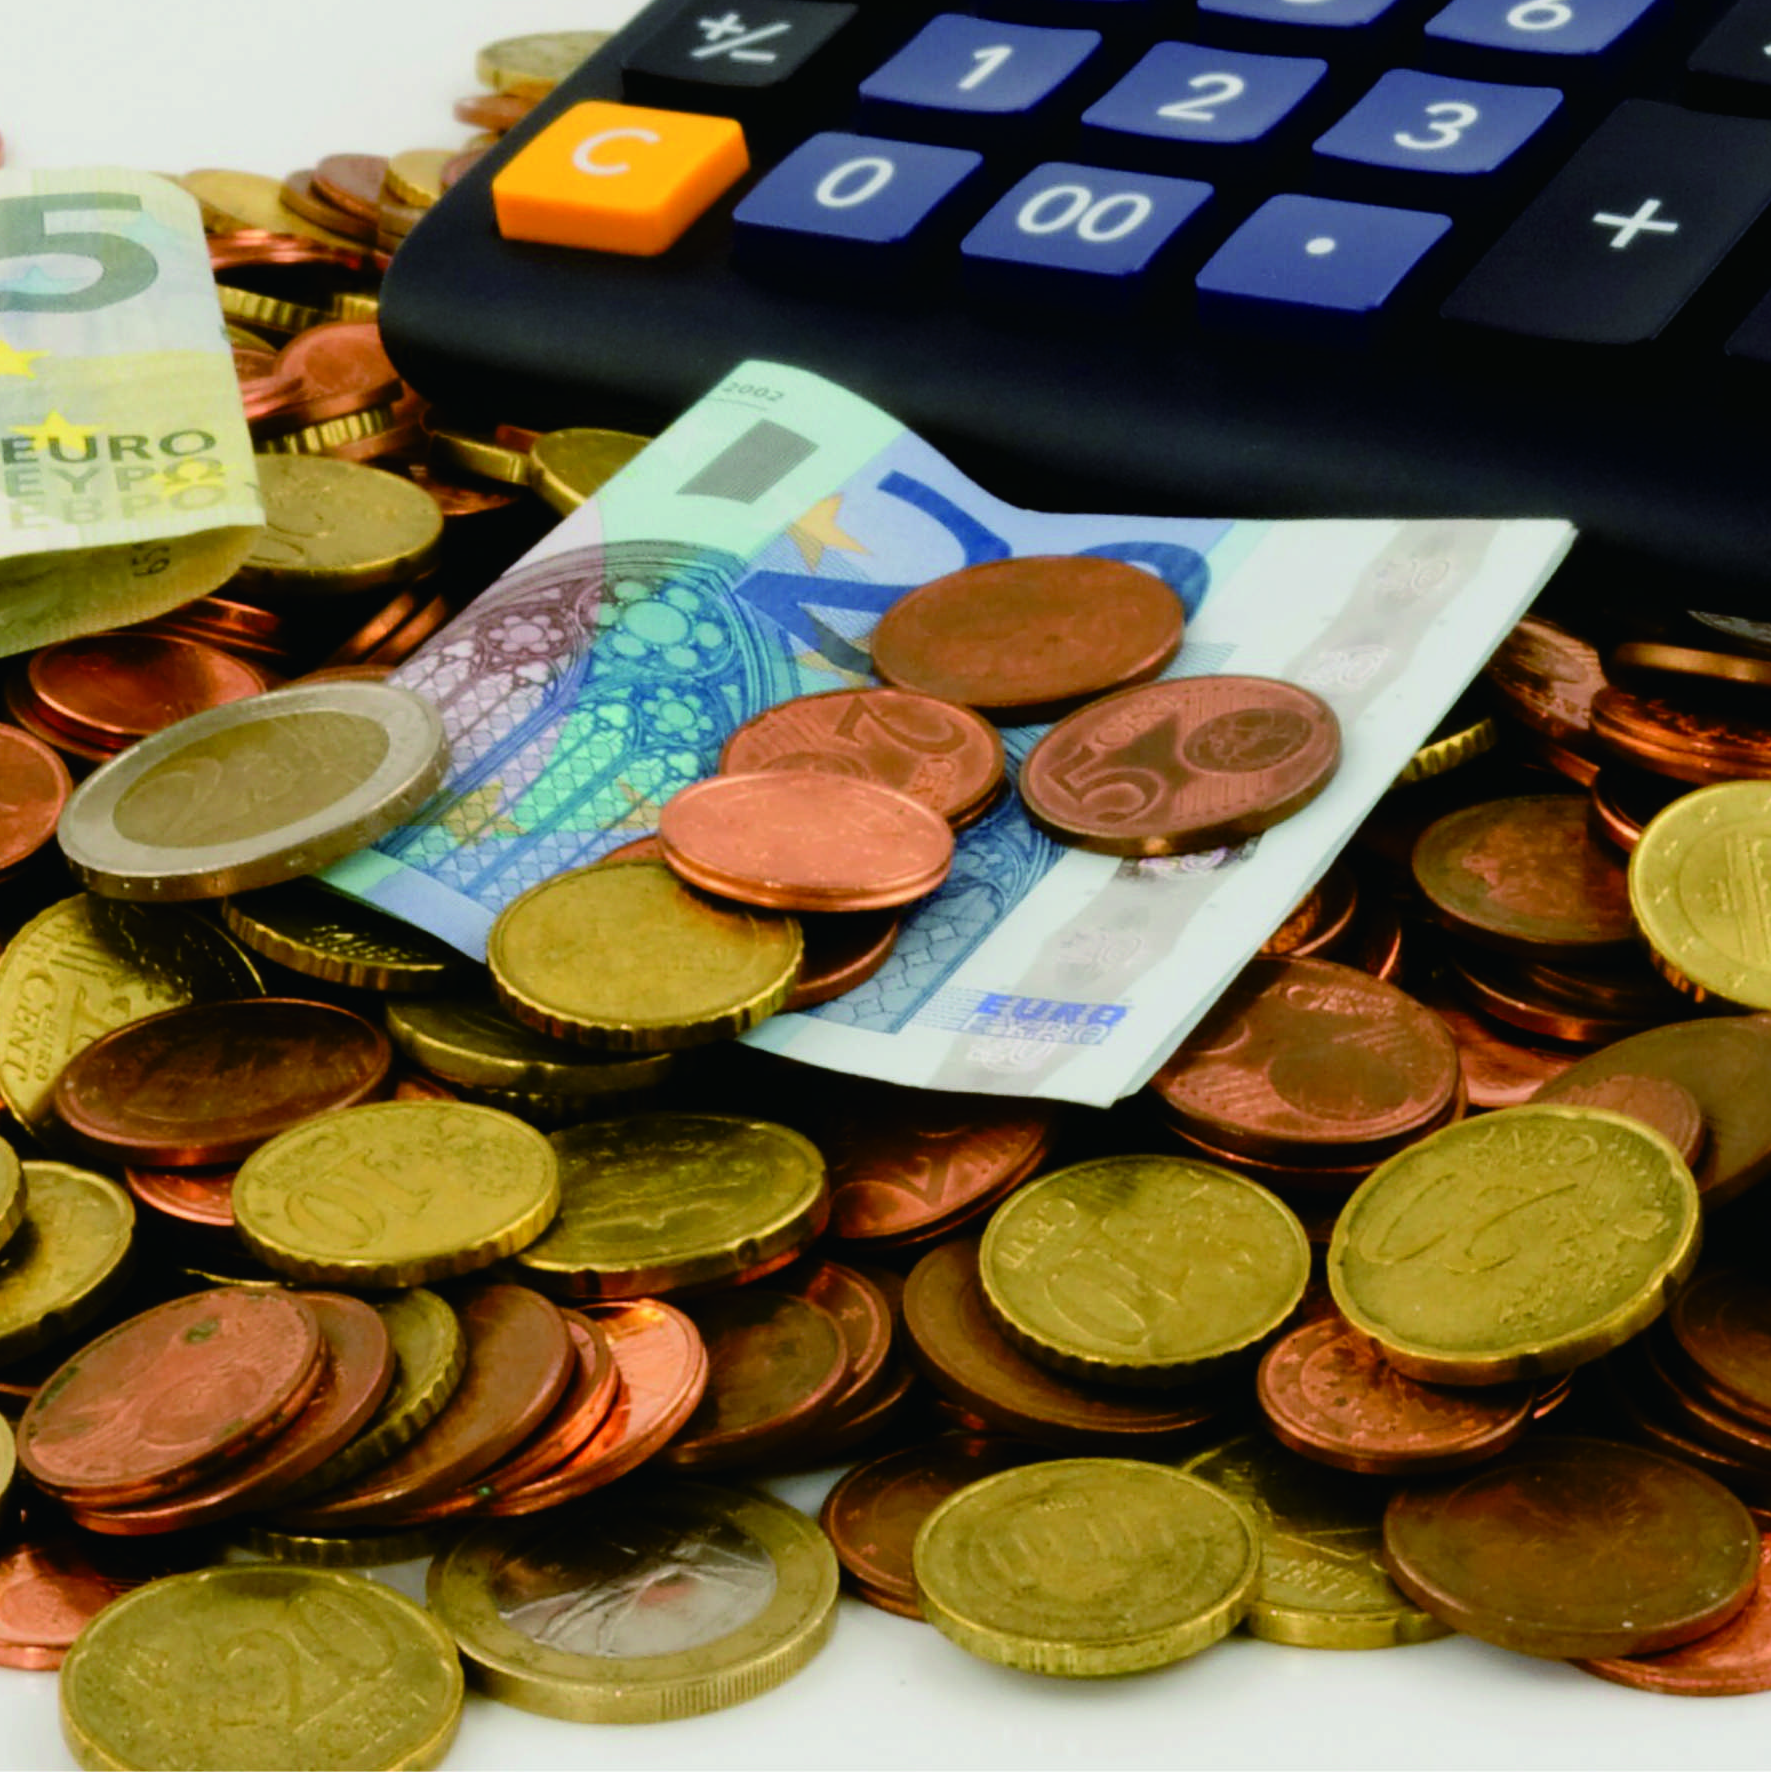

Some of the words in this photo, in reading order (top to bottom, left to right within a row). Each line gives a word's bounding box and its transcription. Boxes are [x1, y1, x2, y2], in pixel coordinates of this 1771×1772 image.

[959, 46, 1012, 90] 1
[1158, 74, 1244, 121] 2
[1395, 103, 1478, 150] 3
[572, 128, 660, 176] C
[816, 157, 894, 207] 0
[1018, 185, 1151, 241] 00
[1, 429, 217, 464] EURO
[1046, 745, 1166, 825] 5
[2, 969, 58, 1083] CENT
